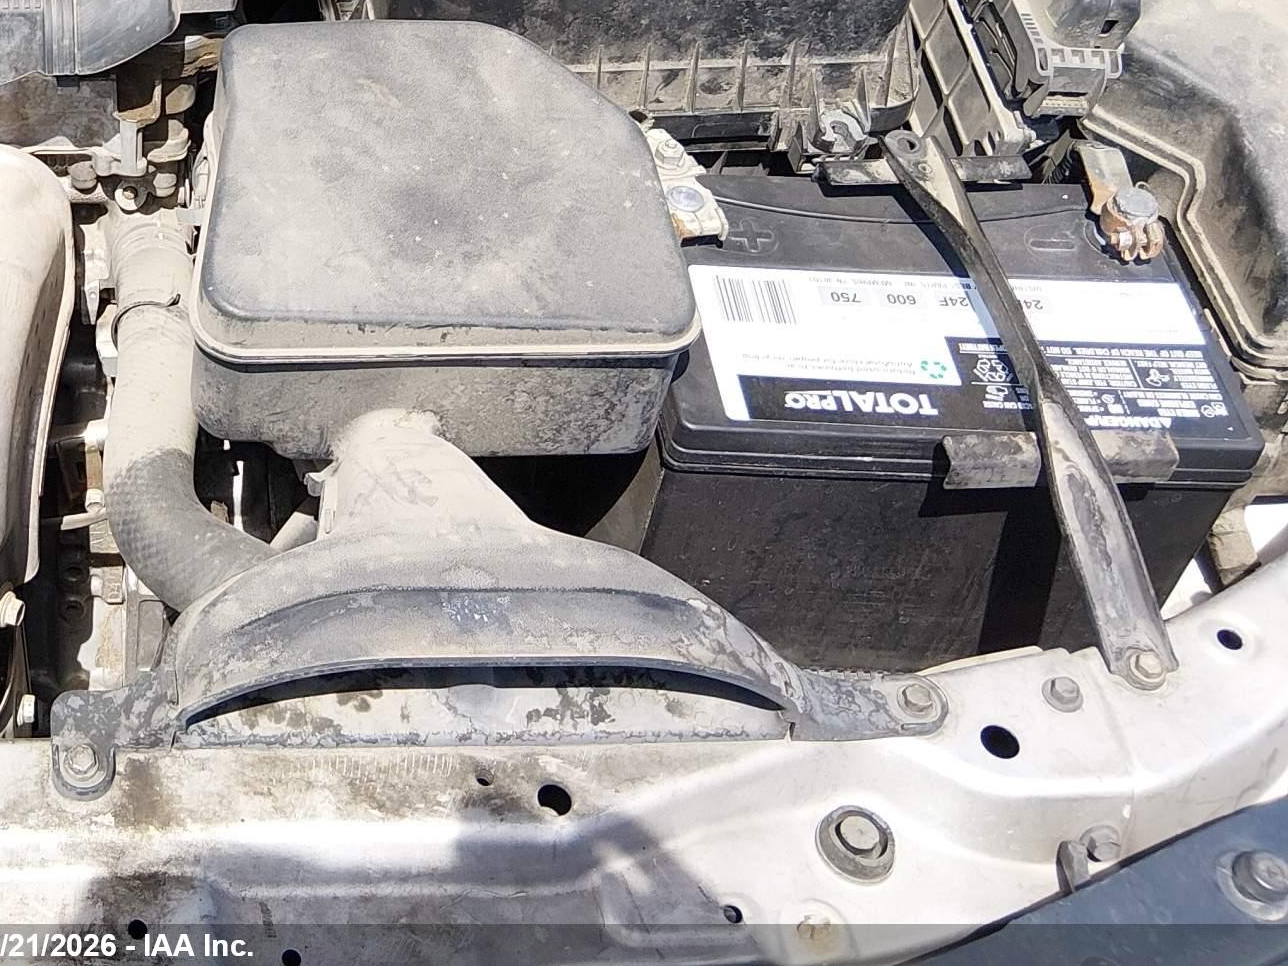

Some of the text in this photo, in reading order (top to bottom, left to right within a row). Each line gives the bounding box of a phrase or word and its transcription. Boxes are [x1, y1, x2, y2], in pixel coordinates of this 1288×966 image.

[830, 291, 1043, 310] 24 24F 600 750
[784, 390, 938, 416] TOTALPRO
